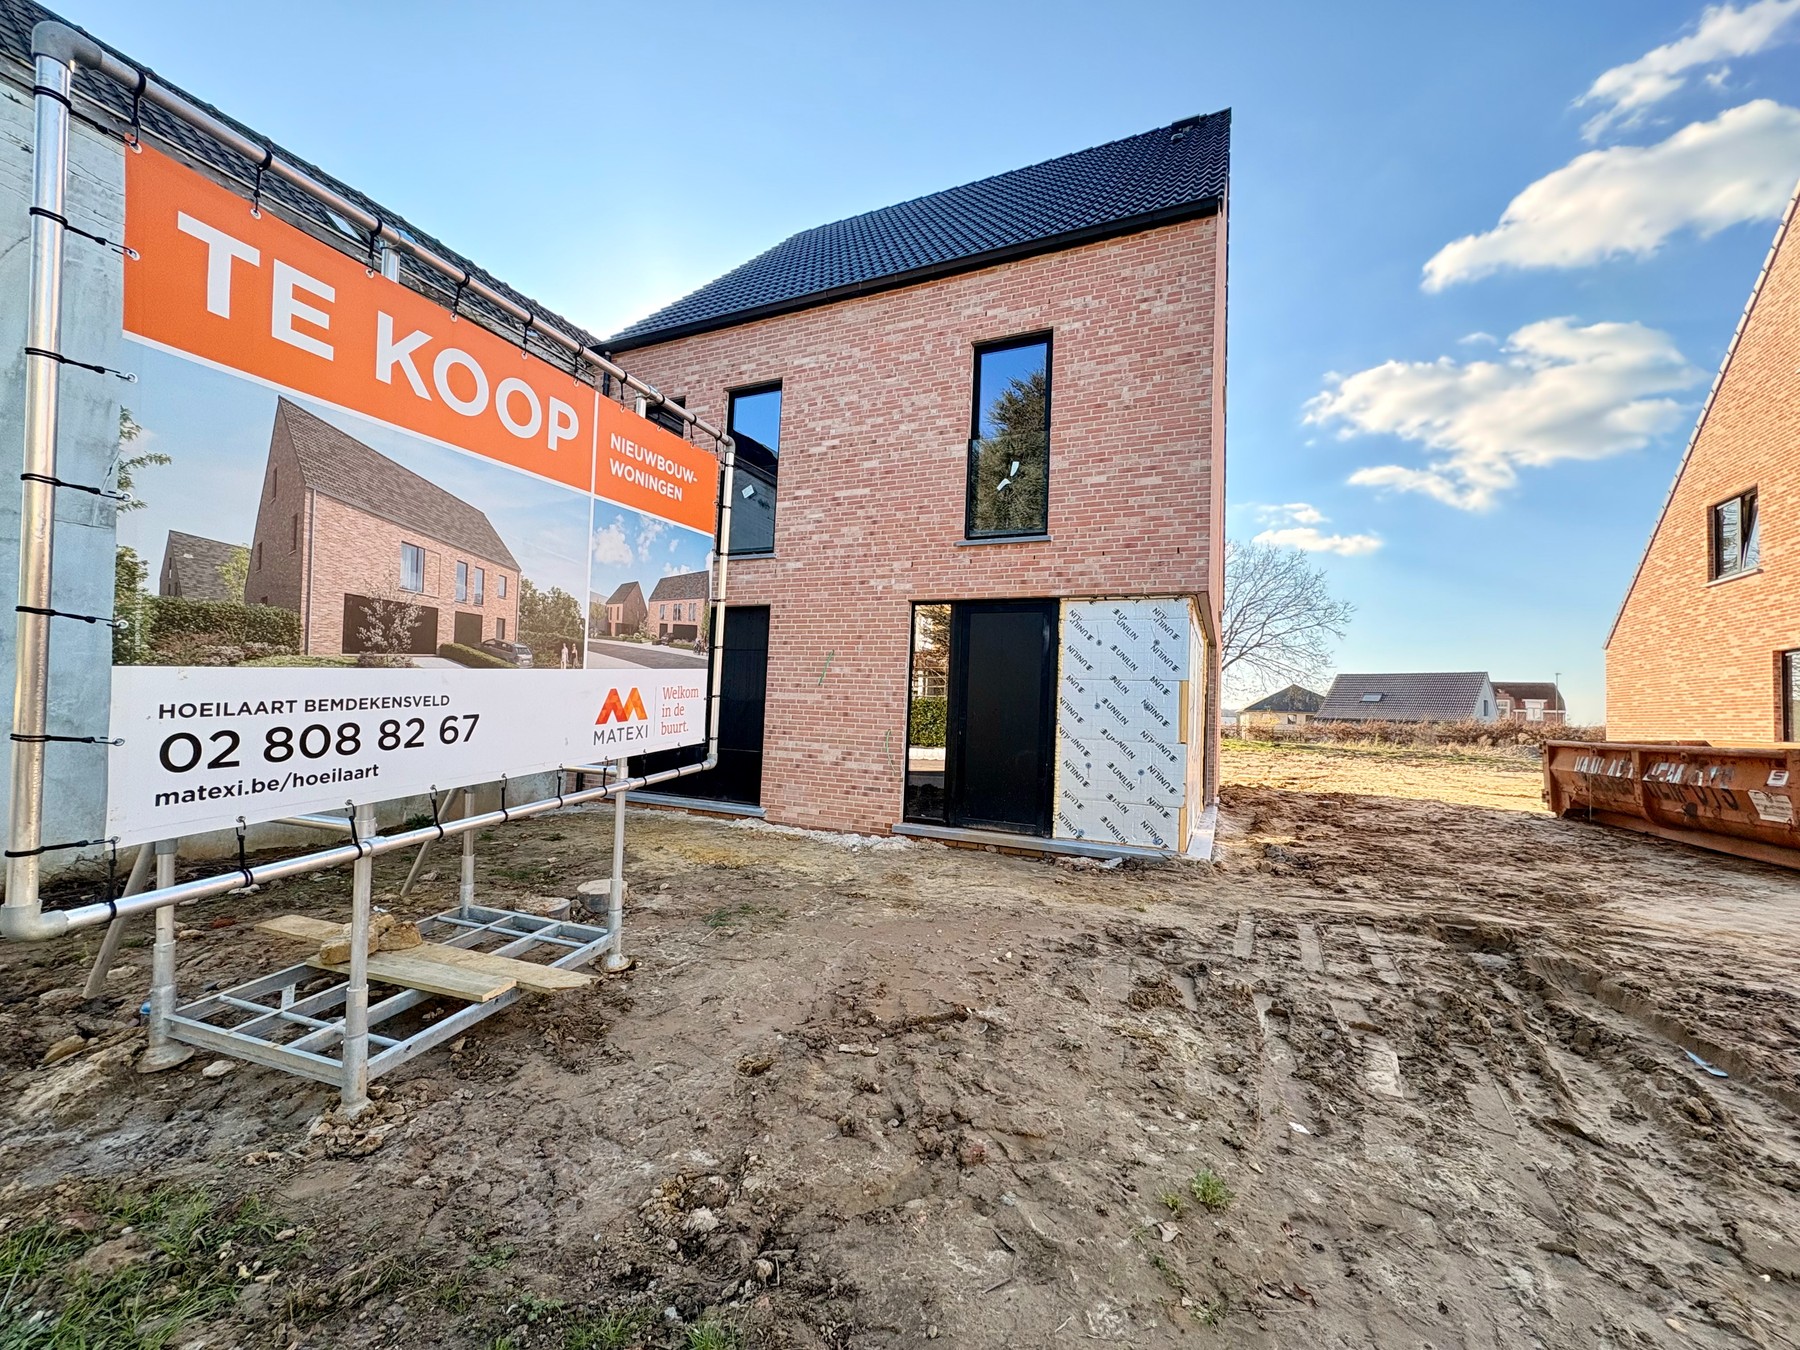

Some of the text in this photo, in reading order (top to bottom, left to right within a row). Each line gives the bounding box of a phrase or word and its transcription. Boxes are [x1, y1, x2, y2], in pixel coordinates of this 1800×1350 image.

[176, 210, 579, 451] TE KOOP
[610, 433, 698, 483] NIEUWBOUW-
[609, 458, 682, 501] WONINGEN
[158, 695, 450, 719] HOEILAART BEMDEKENSVELD
[662, 686, 699, 700] Welkom
[661, 703, 685, 718] in de
[159, 714, 480, 773] 02 808 82 67
[593, 725, 648, 746] MATEXI
[661, 721, 689, 736] buurt.
[155, 764, 379, 807] matexi.be/hoeilaart
